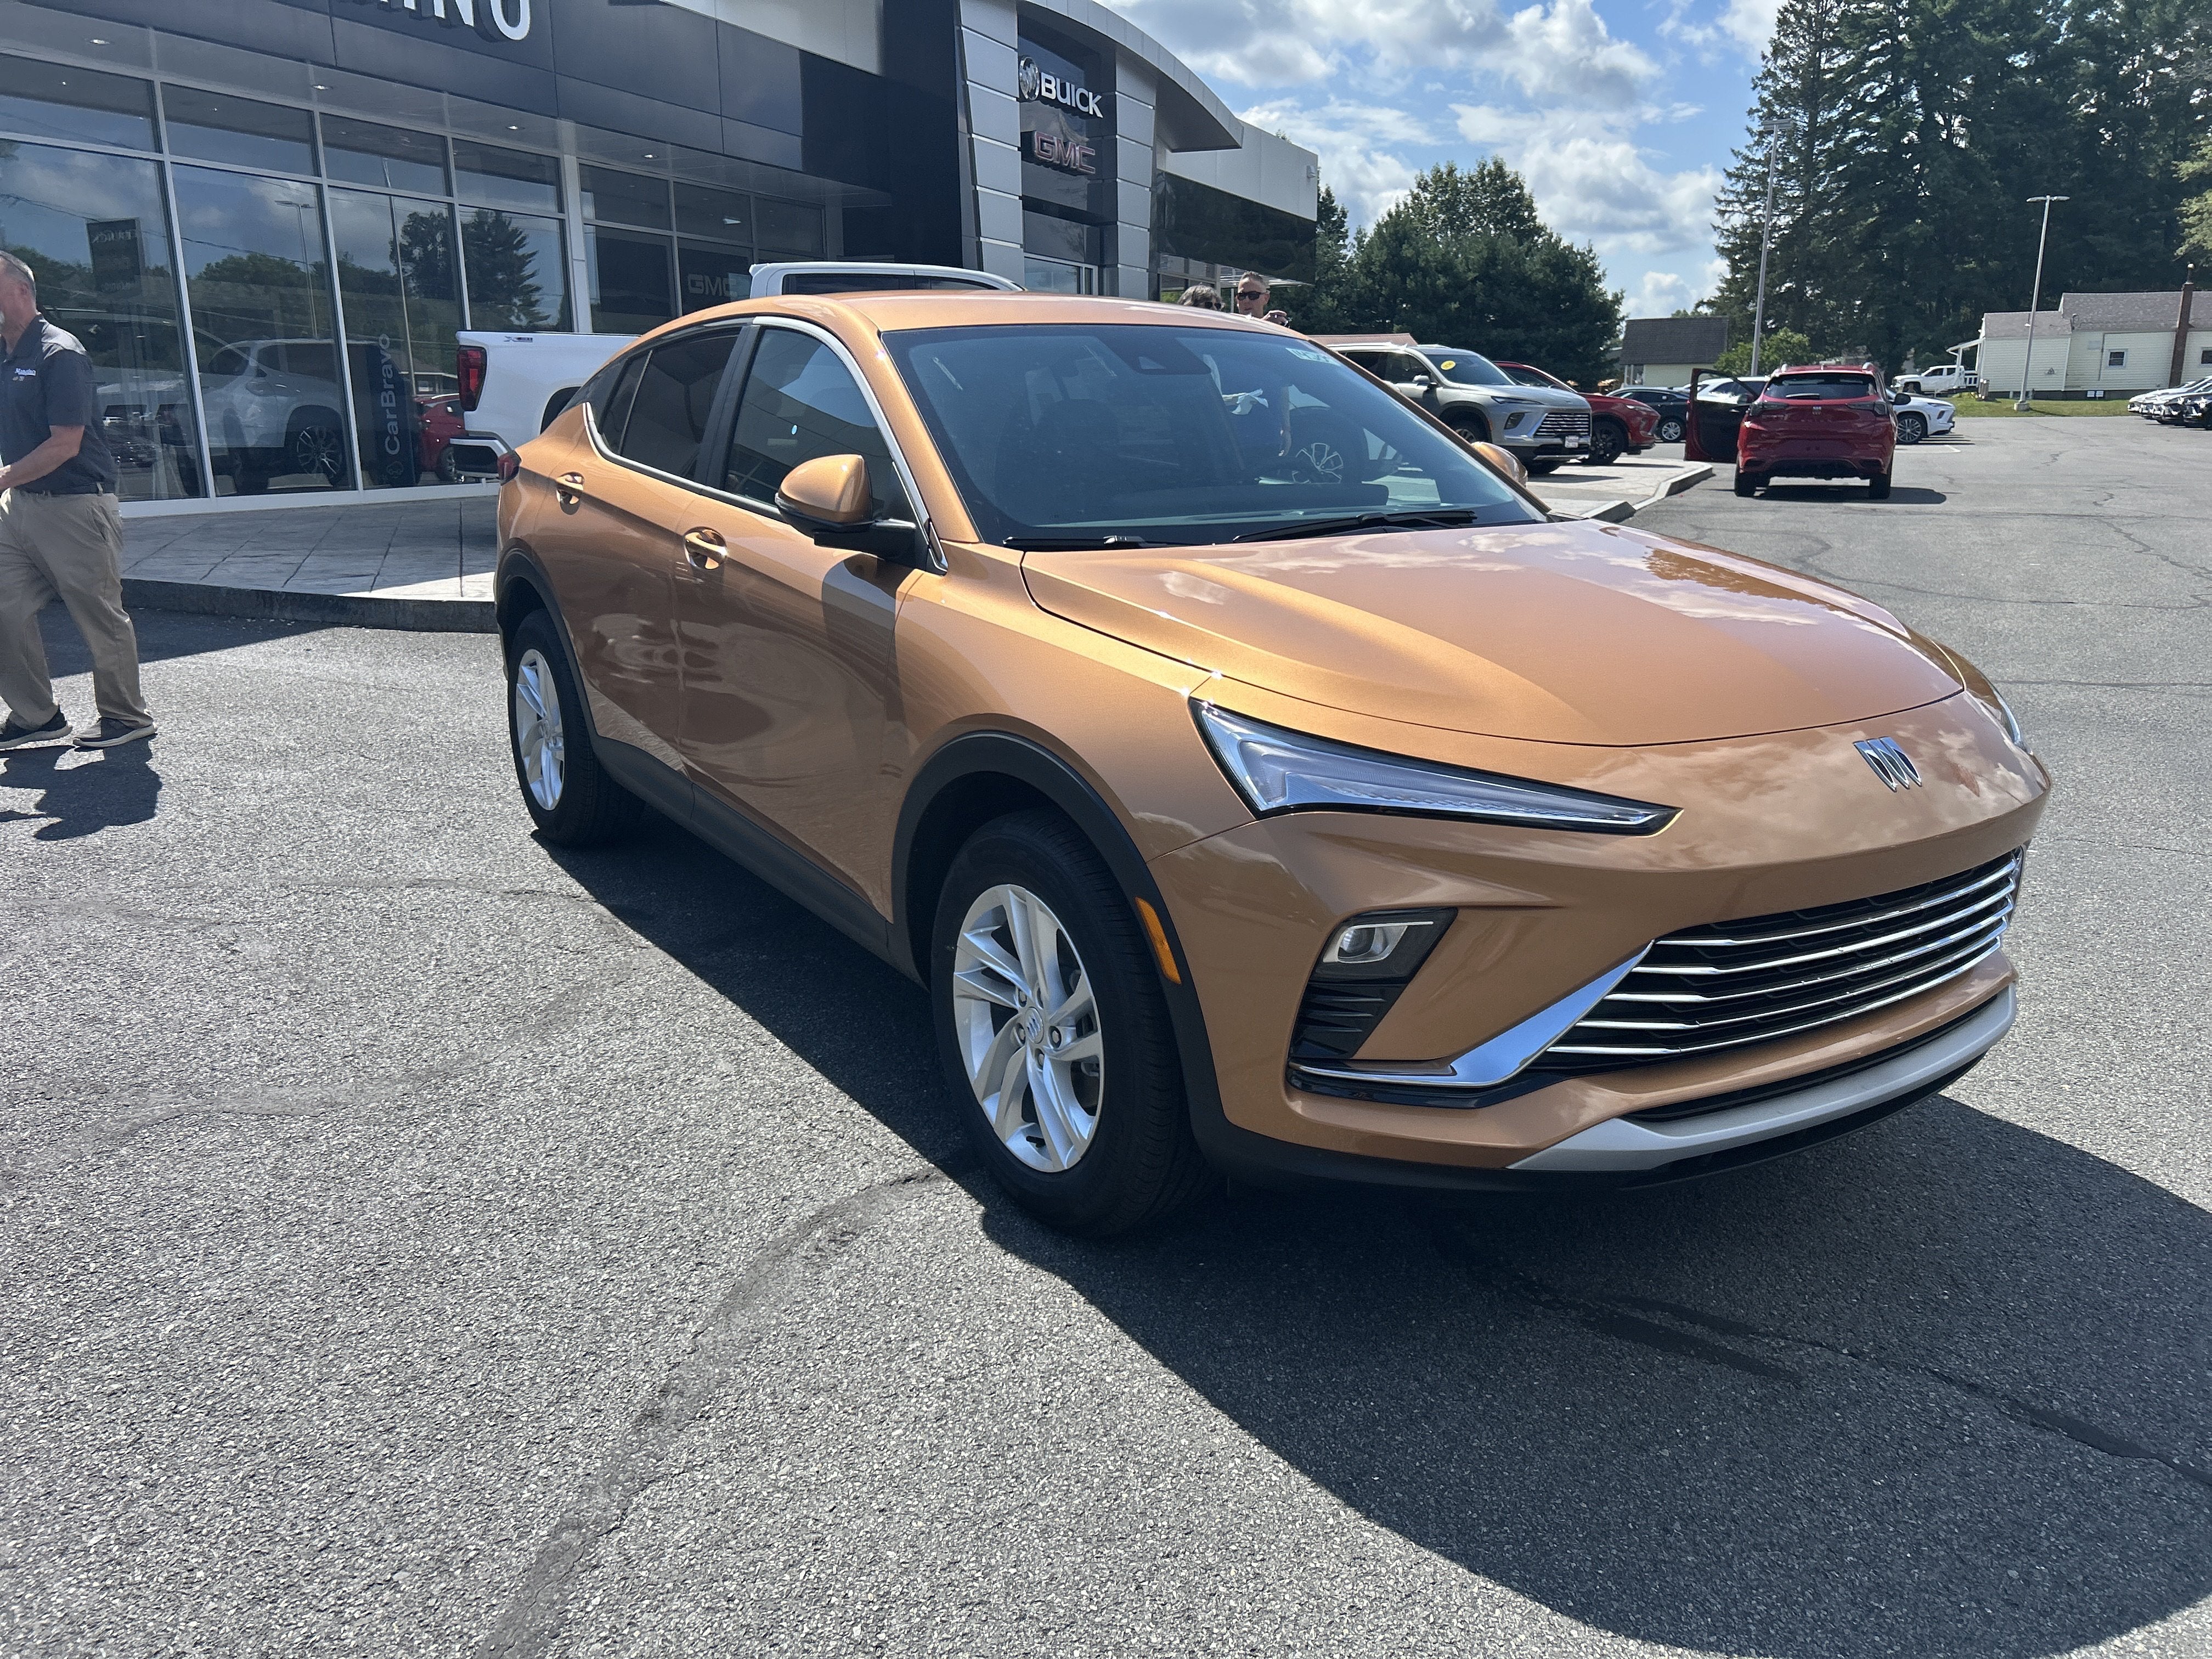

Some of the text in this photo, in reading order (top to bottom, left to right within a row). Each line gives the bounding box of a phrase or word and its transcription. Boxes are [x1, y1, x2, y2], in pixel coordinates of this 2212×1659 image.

[1041, 72, 1103, 118] BUICK
[1035, 131, 1096, 174] GMC
[687, 273, 738, 298] GMC
[379, 334, 400, 455] CarBravo
